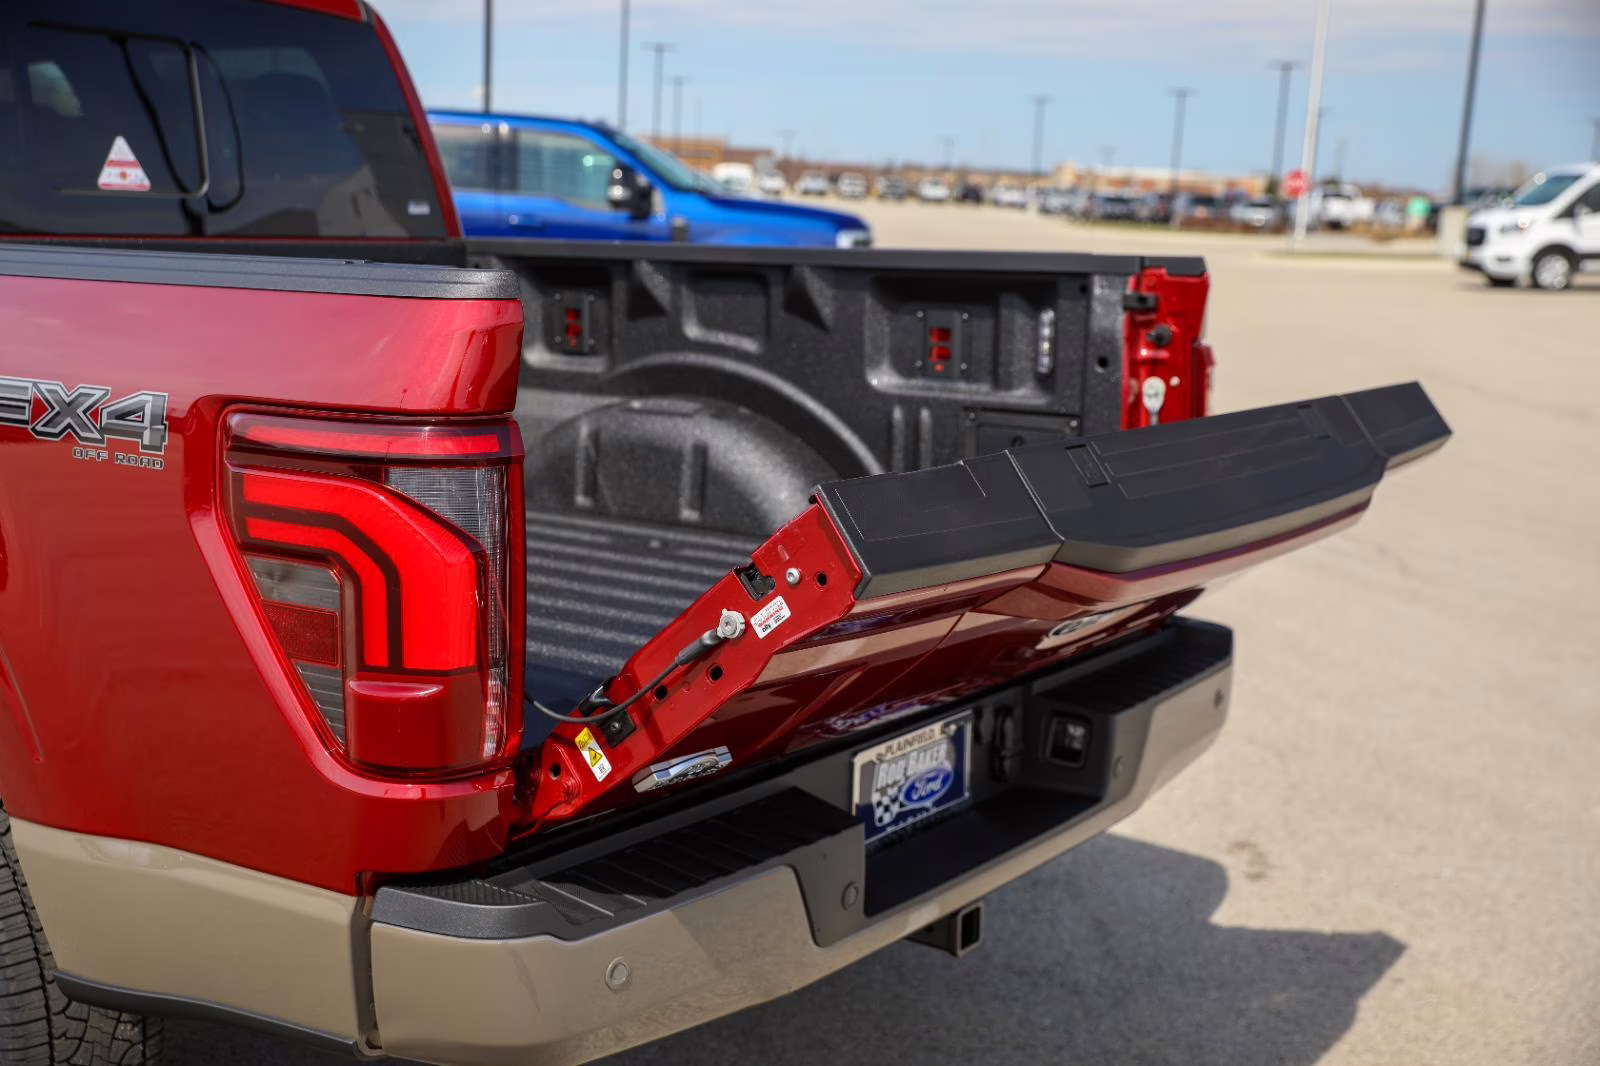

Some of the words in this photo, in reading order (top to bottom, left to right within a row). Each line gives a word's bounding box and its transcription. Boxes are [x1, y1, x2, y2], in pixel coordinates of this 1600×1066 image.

[72, 447, 108, 461] OFF
[115, 452, 164, 470] ROAD
[911, 771, 944, 801] Ford
